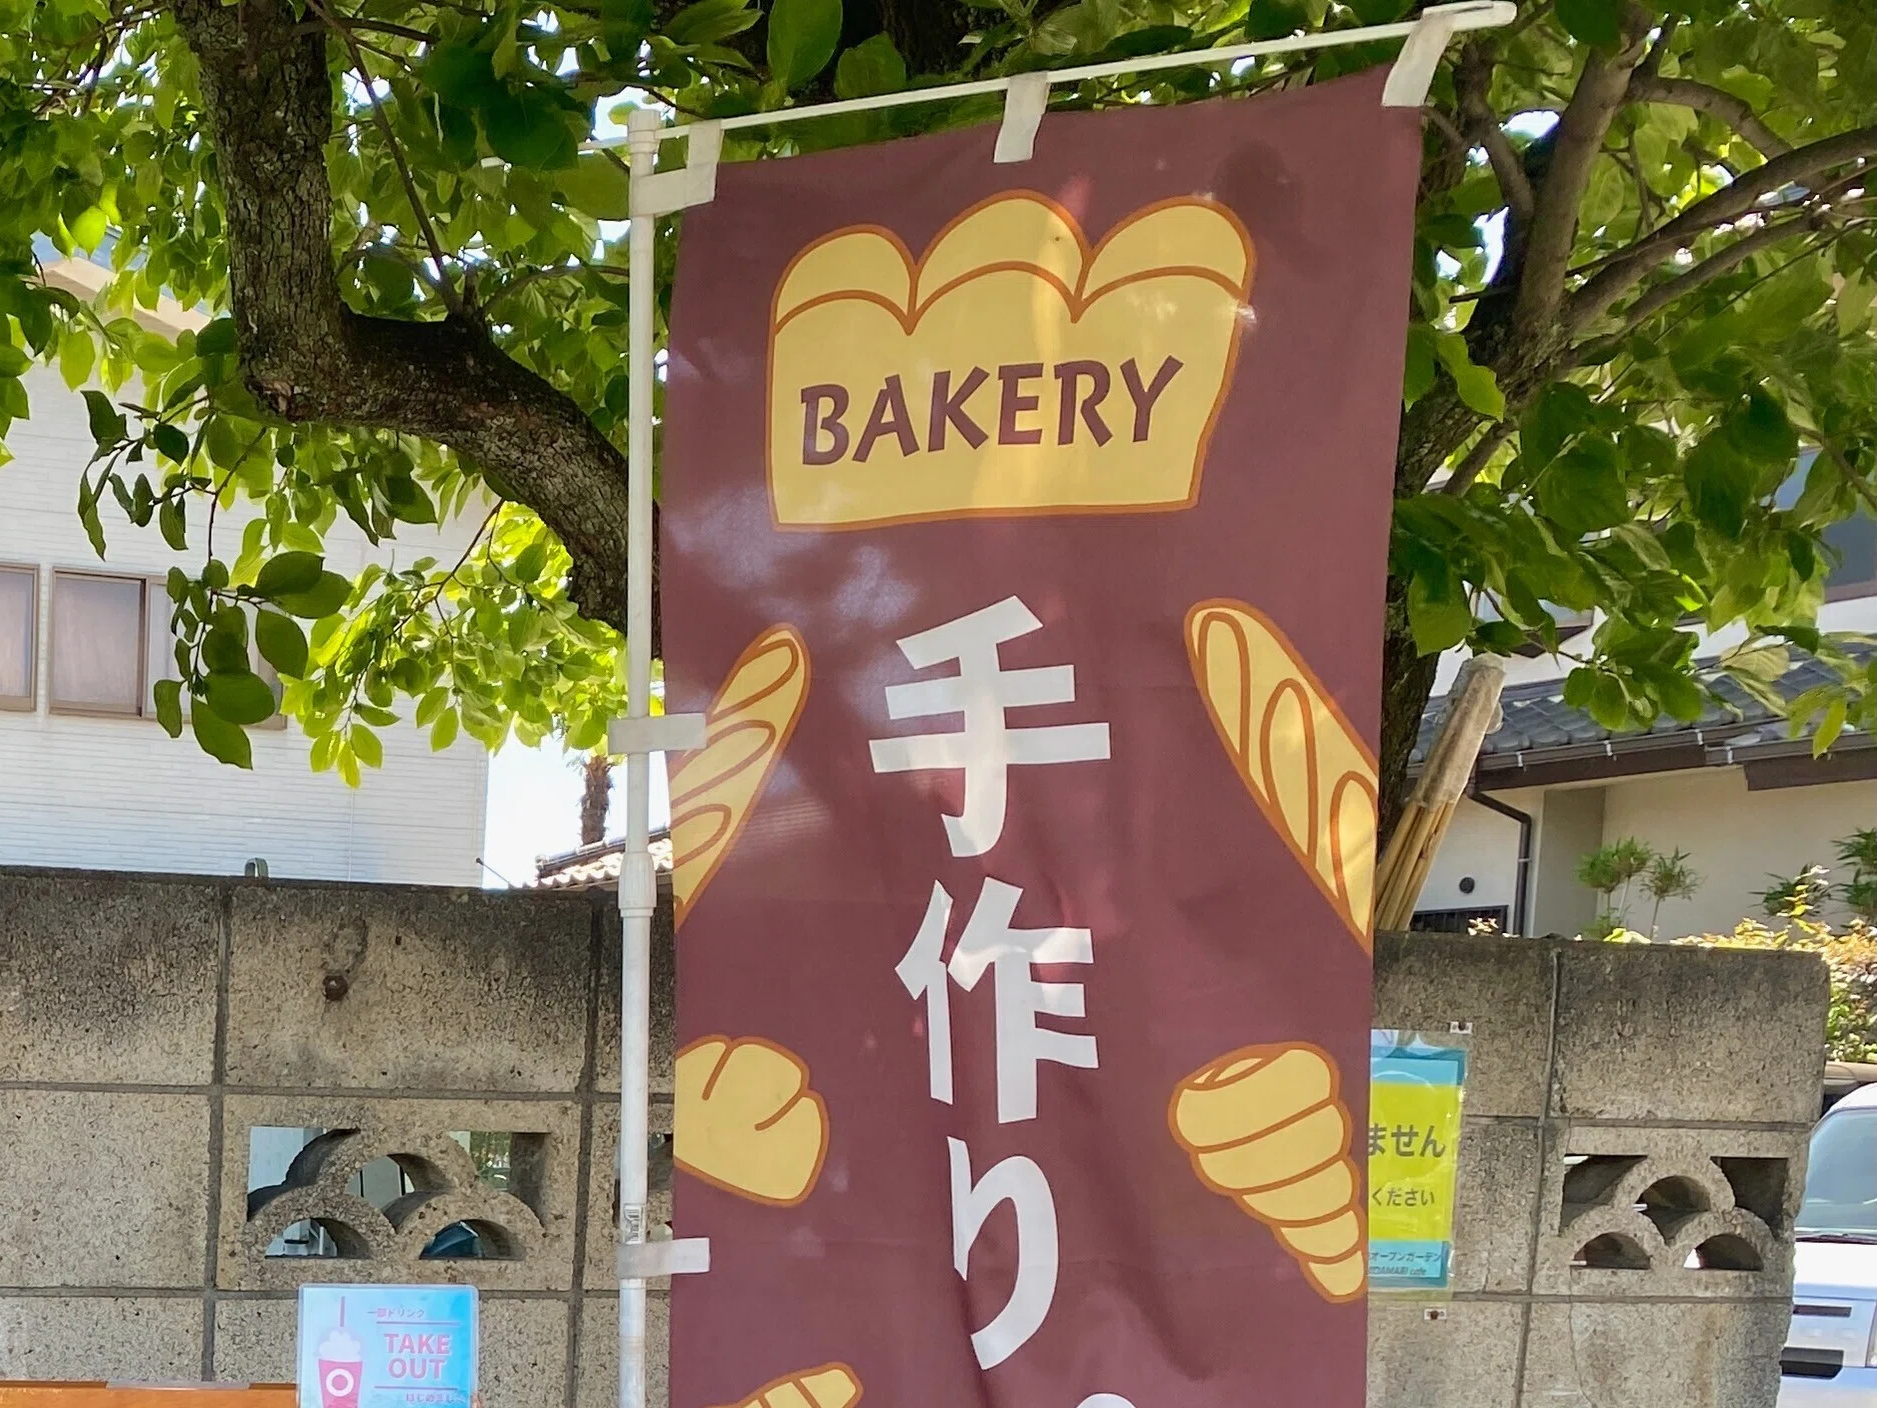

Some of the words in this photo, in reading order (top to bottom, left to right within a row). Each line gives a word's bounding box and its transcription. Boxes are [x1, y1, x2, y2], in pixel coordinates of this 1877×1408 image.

[800, 355, 1184, 465] BAKERY
[1372, 1187, 1435, 1207] ください
[383, 1333, 451, 1355] TAKE
[388, 1357, 445, 1379] OUT
